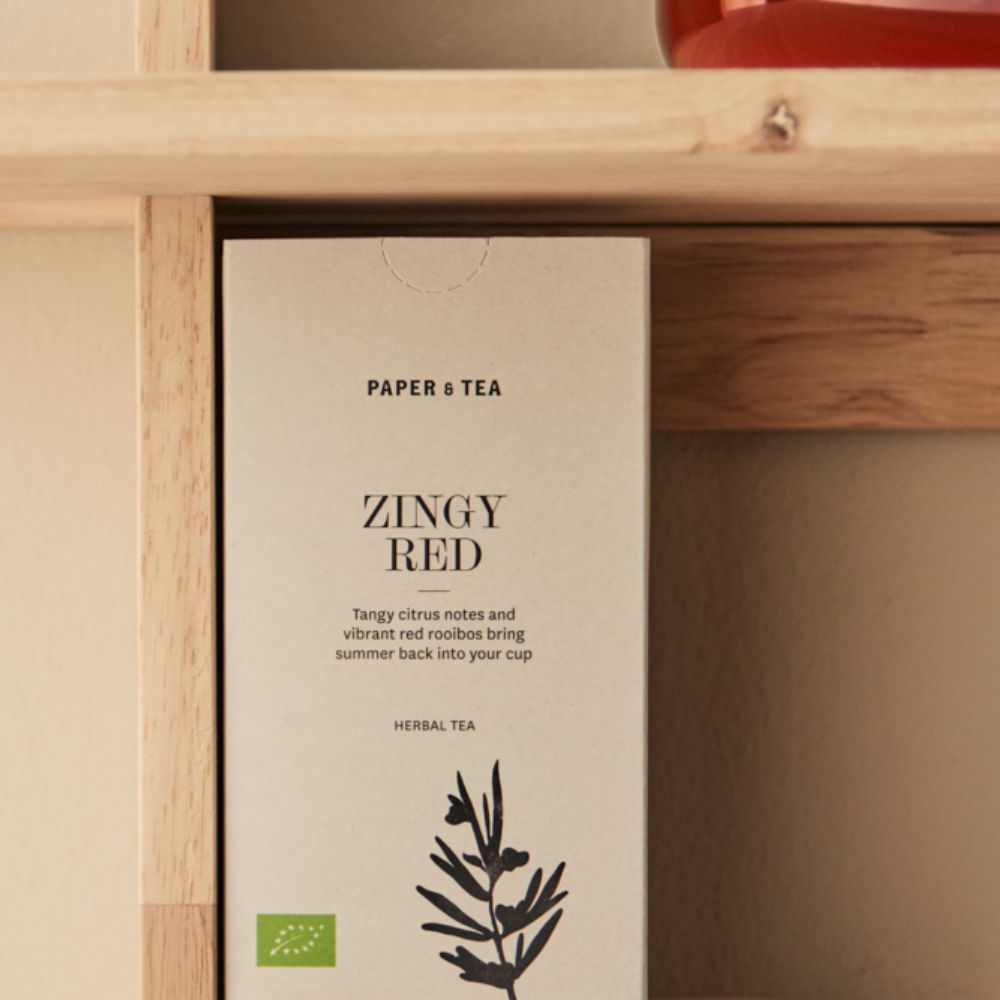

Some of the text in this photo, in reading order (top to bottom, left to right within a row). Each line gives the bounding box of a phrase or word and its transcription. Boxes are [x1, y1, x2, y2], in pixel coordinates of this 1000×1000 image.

[367, 378, 502, 397] PAPER & TEA
[362, 493, 507, 530] ZINGY
[385, 536, 483, 572] RED
[352, 607, 516, 625] Tangy citrus notes and
[343, 626, 526, 644] vibrant red rooibos bring
[335, 646, 533, 664] summer back into your cup
[394, 719, 476, 732] HERBAL TEA
